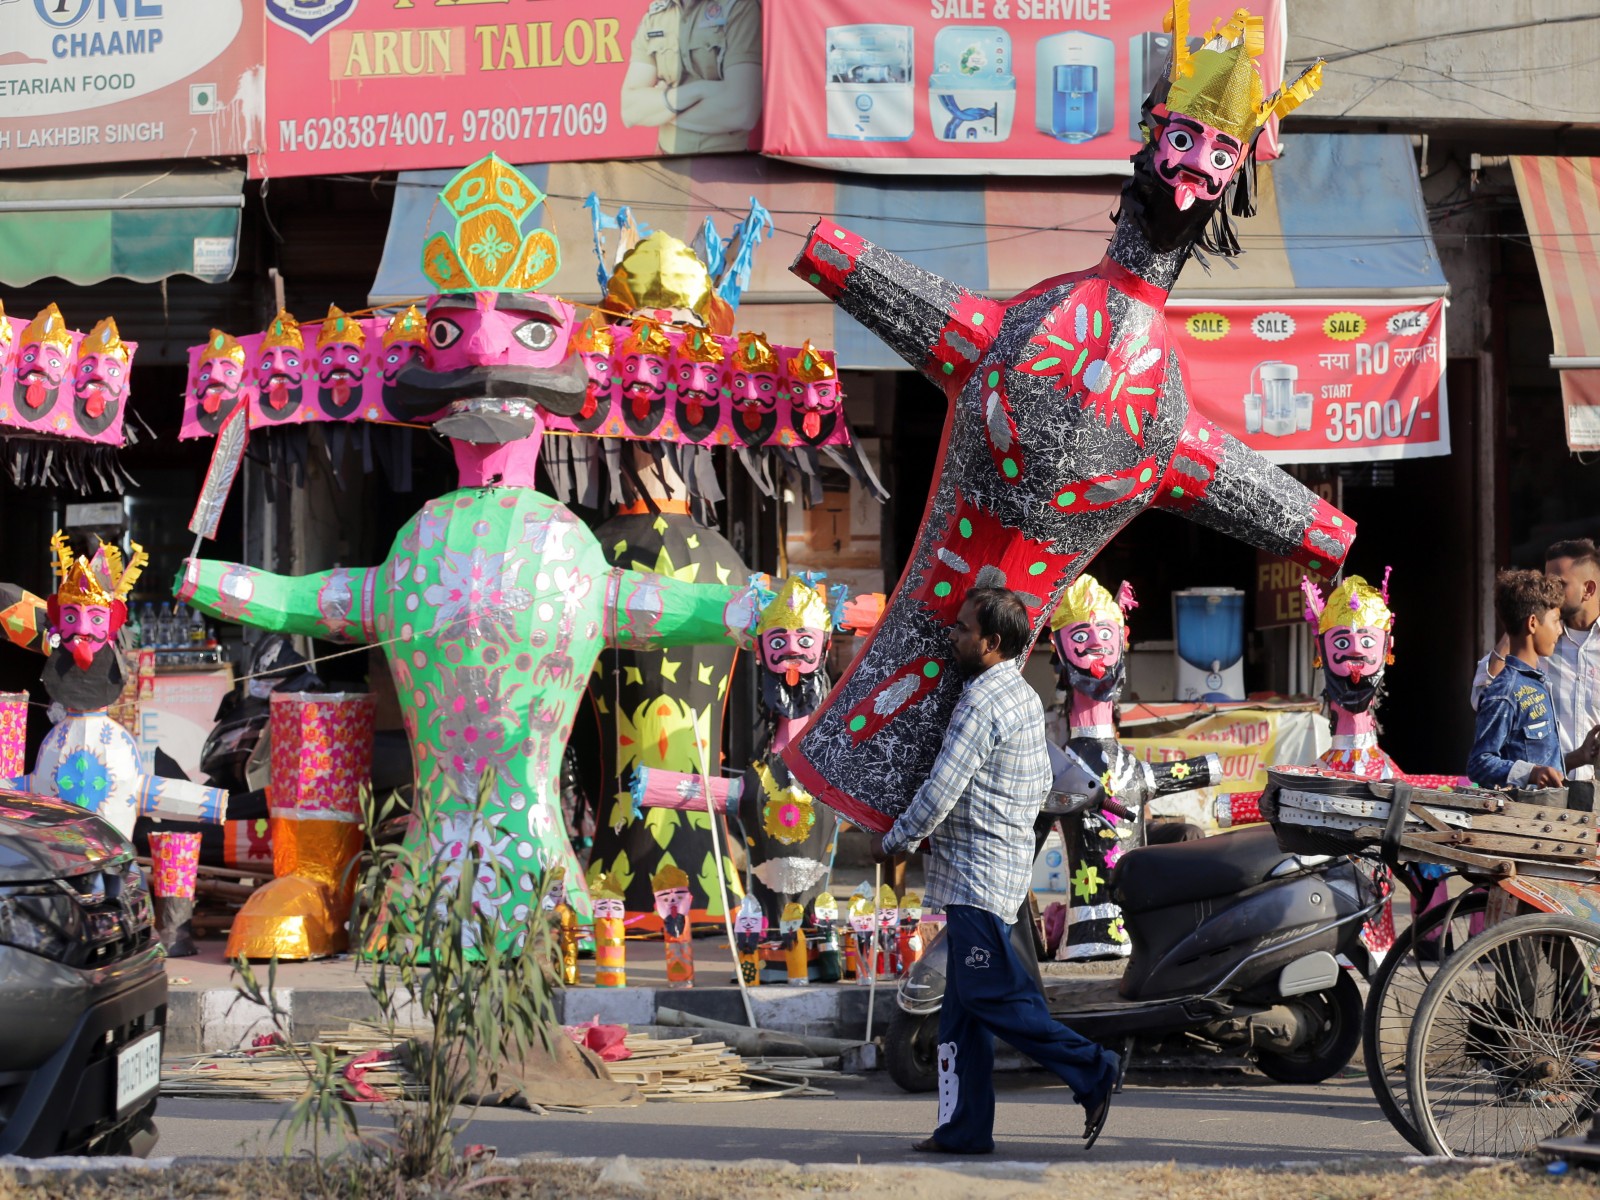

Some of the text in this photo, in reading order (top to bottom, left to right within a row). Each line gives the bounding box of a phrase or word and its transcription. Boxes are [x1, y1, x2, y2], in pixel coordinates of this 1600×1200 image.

[930, 0, 1111, 21] SALE & SERVICE
[52, 28, 163, 59] CHAAMP
[344, 18, 624, 77] ARUN TAILOR
[82, 73, 135, 92] FOOD
[16, 126, 100, 148] LAKHBIR
[105, 121, 164, 143] SINGH
[279, 102, 607, 152] M-6283874007, 9780777069
[1192, 319, 1224, 333] SALE
[1257, 319, 1289, 334] SALE
[1329, 319, 1360, 333] SALE
[1392, 314, 1422, 329] SALE
[1318, 353, 1350, 371] नया
[1356, 341, 1389, 376] RO
[1321, 384, 1352, 399] START
[1325, 396, 1432, 443] 3500/-
[1258, 561, 1329, 592] FRIDG
